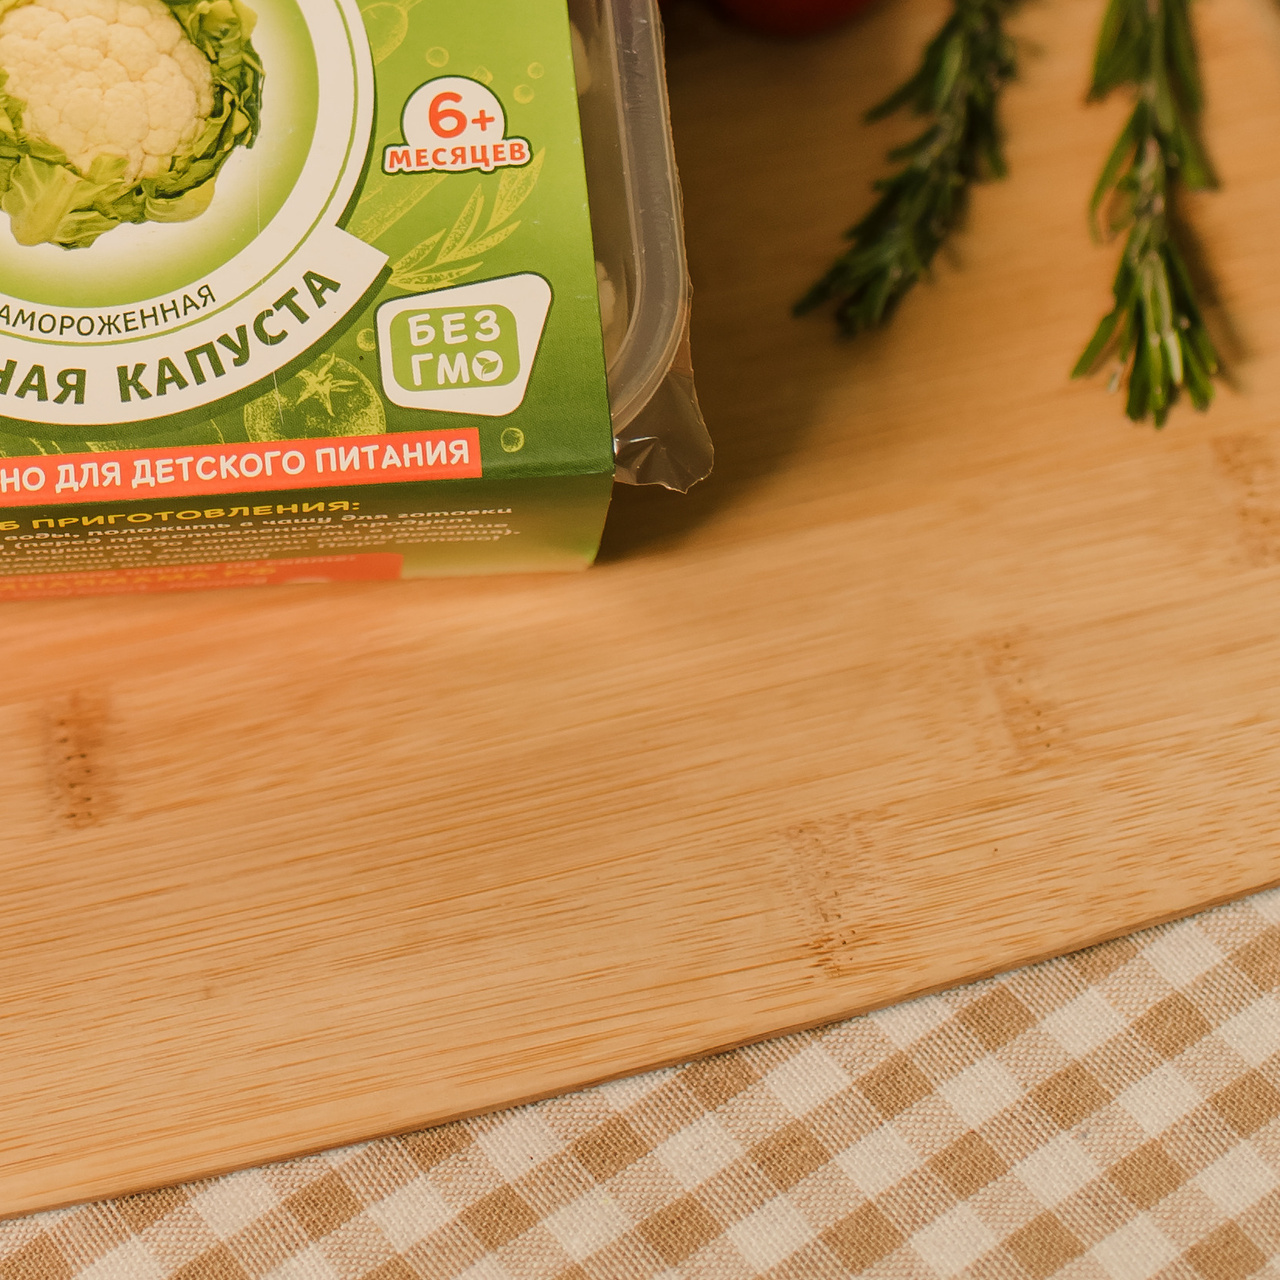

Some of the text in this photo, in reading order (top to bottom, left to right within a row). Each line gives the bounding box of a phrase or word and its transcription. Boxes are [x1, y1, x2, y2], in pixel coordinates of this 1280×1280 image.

[428, 91, 496, 139] 6+
[389, 142, 526, 168] МЕСЯЦЕВ
[116, 269, 343, 404] КАПУСТА
[407, 309, 501, 347] БЕЗ
[411, 350, 504, 386] ГМО
[55, 461, 122, 494] ДЛЯ
[131, 451, 306, 489] ДЕТСКОГО
[316, 439, 470, 473] ПИТАНИЯ
[31, 501, 360, 529] ПРИГОТОВЛЕНИЯ:
[88, 524, 231, 537] положить
